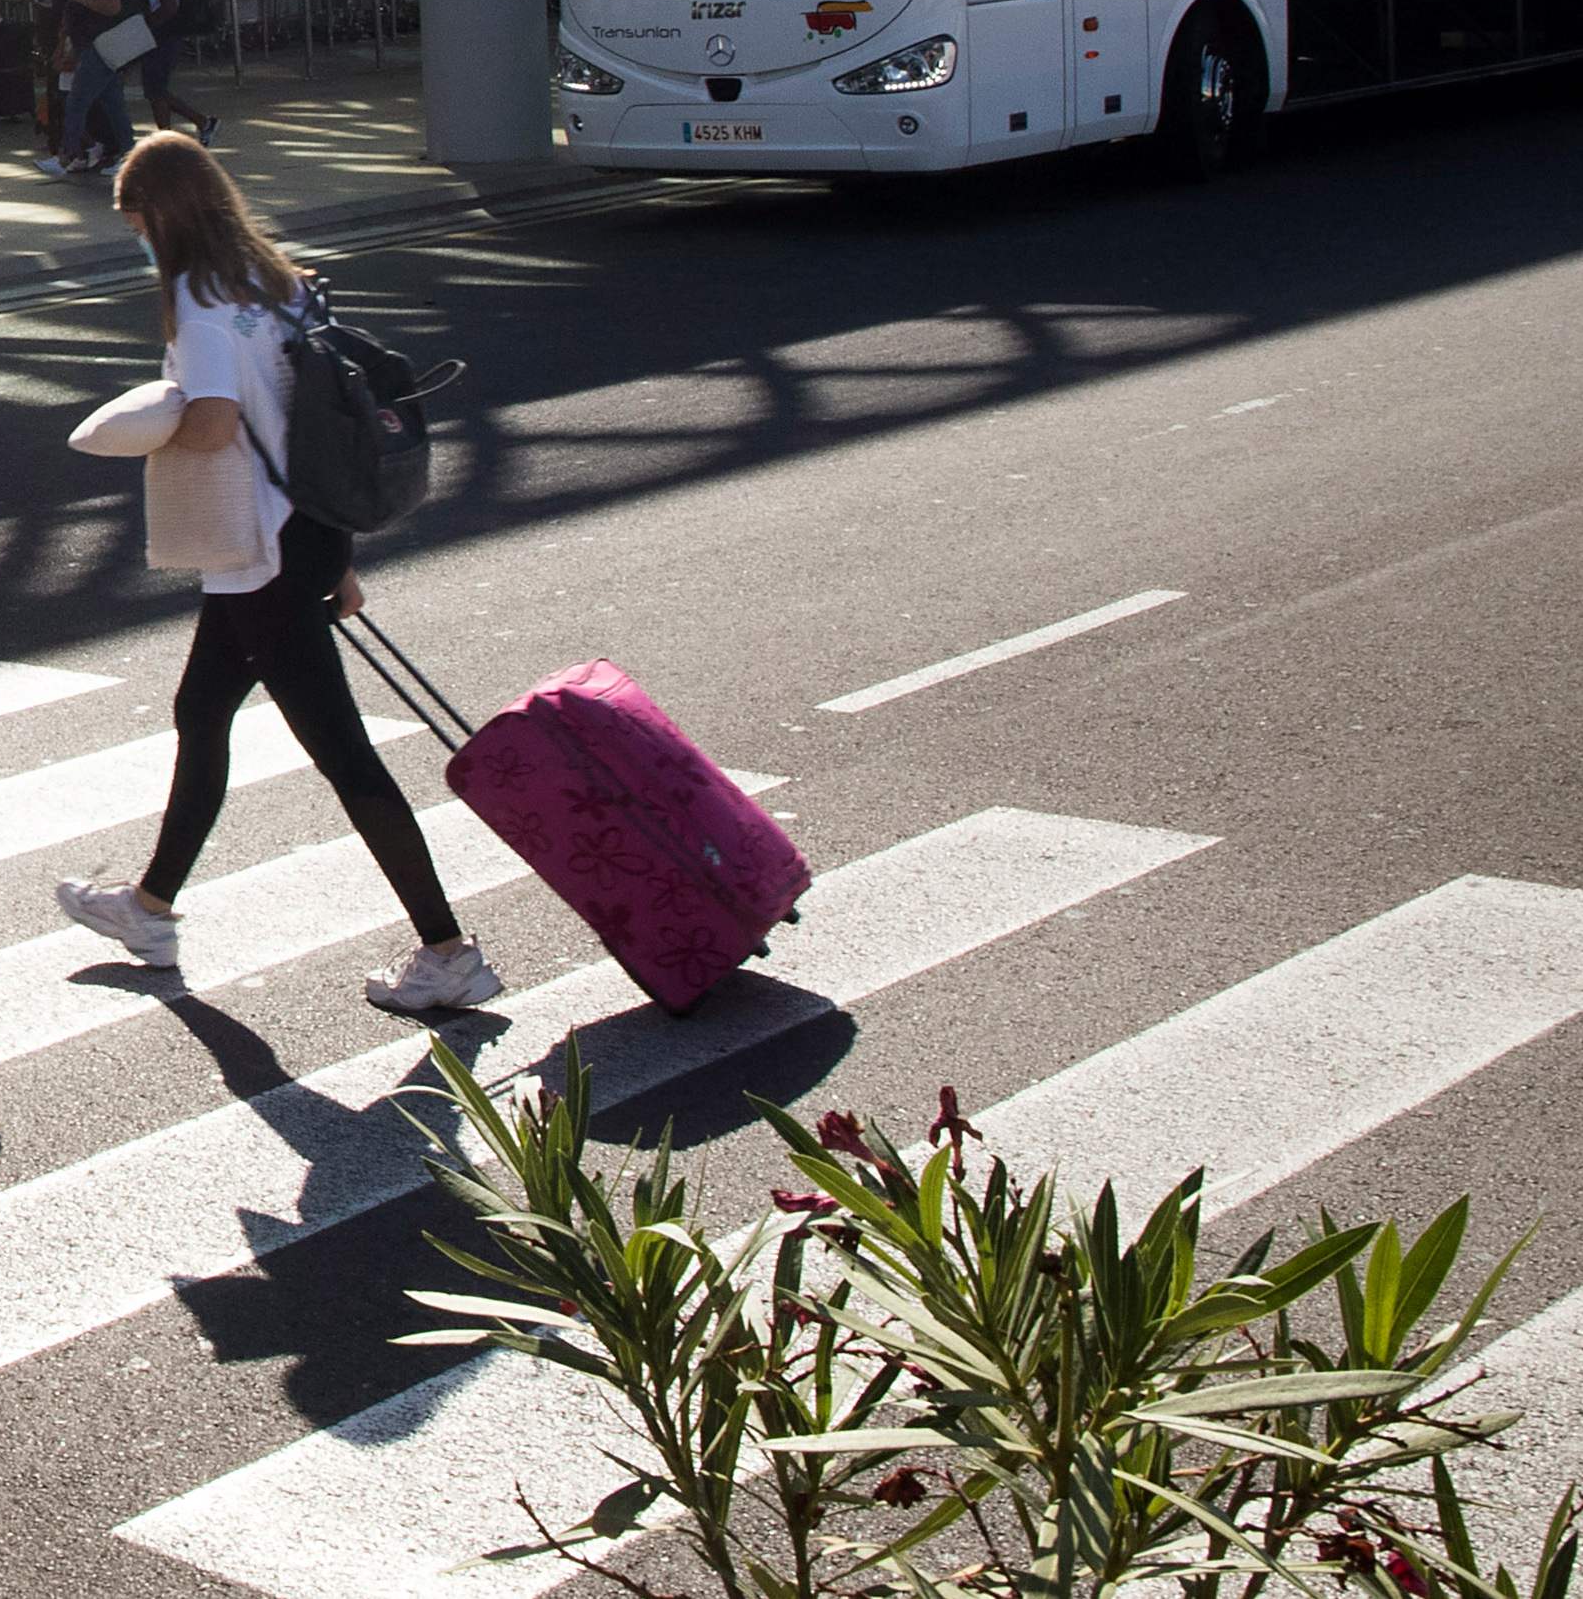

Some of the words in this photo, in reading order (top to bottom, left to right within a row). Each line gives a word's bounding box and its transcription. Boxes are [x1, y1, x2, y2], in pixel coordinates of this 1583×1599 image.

[691, 0, 746, 20] irizar
[591, 26, 682, 39] Transunion
[694, 124, 730, 141] 4525
[733, 124, 763, 141] KHM
